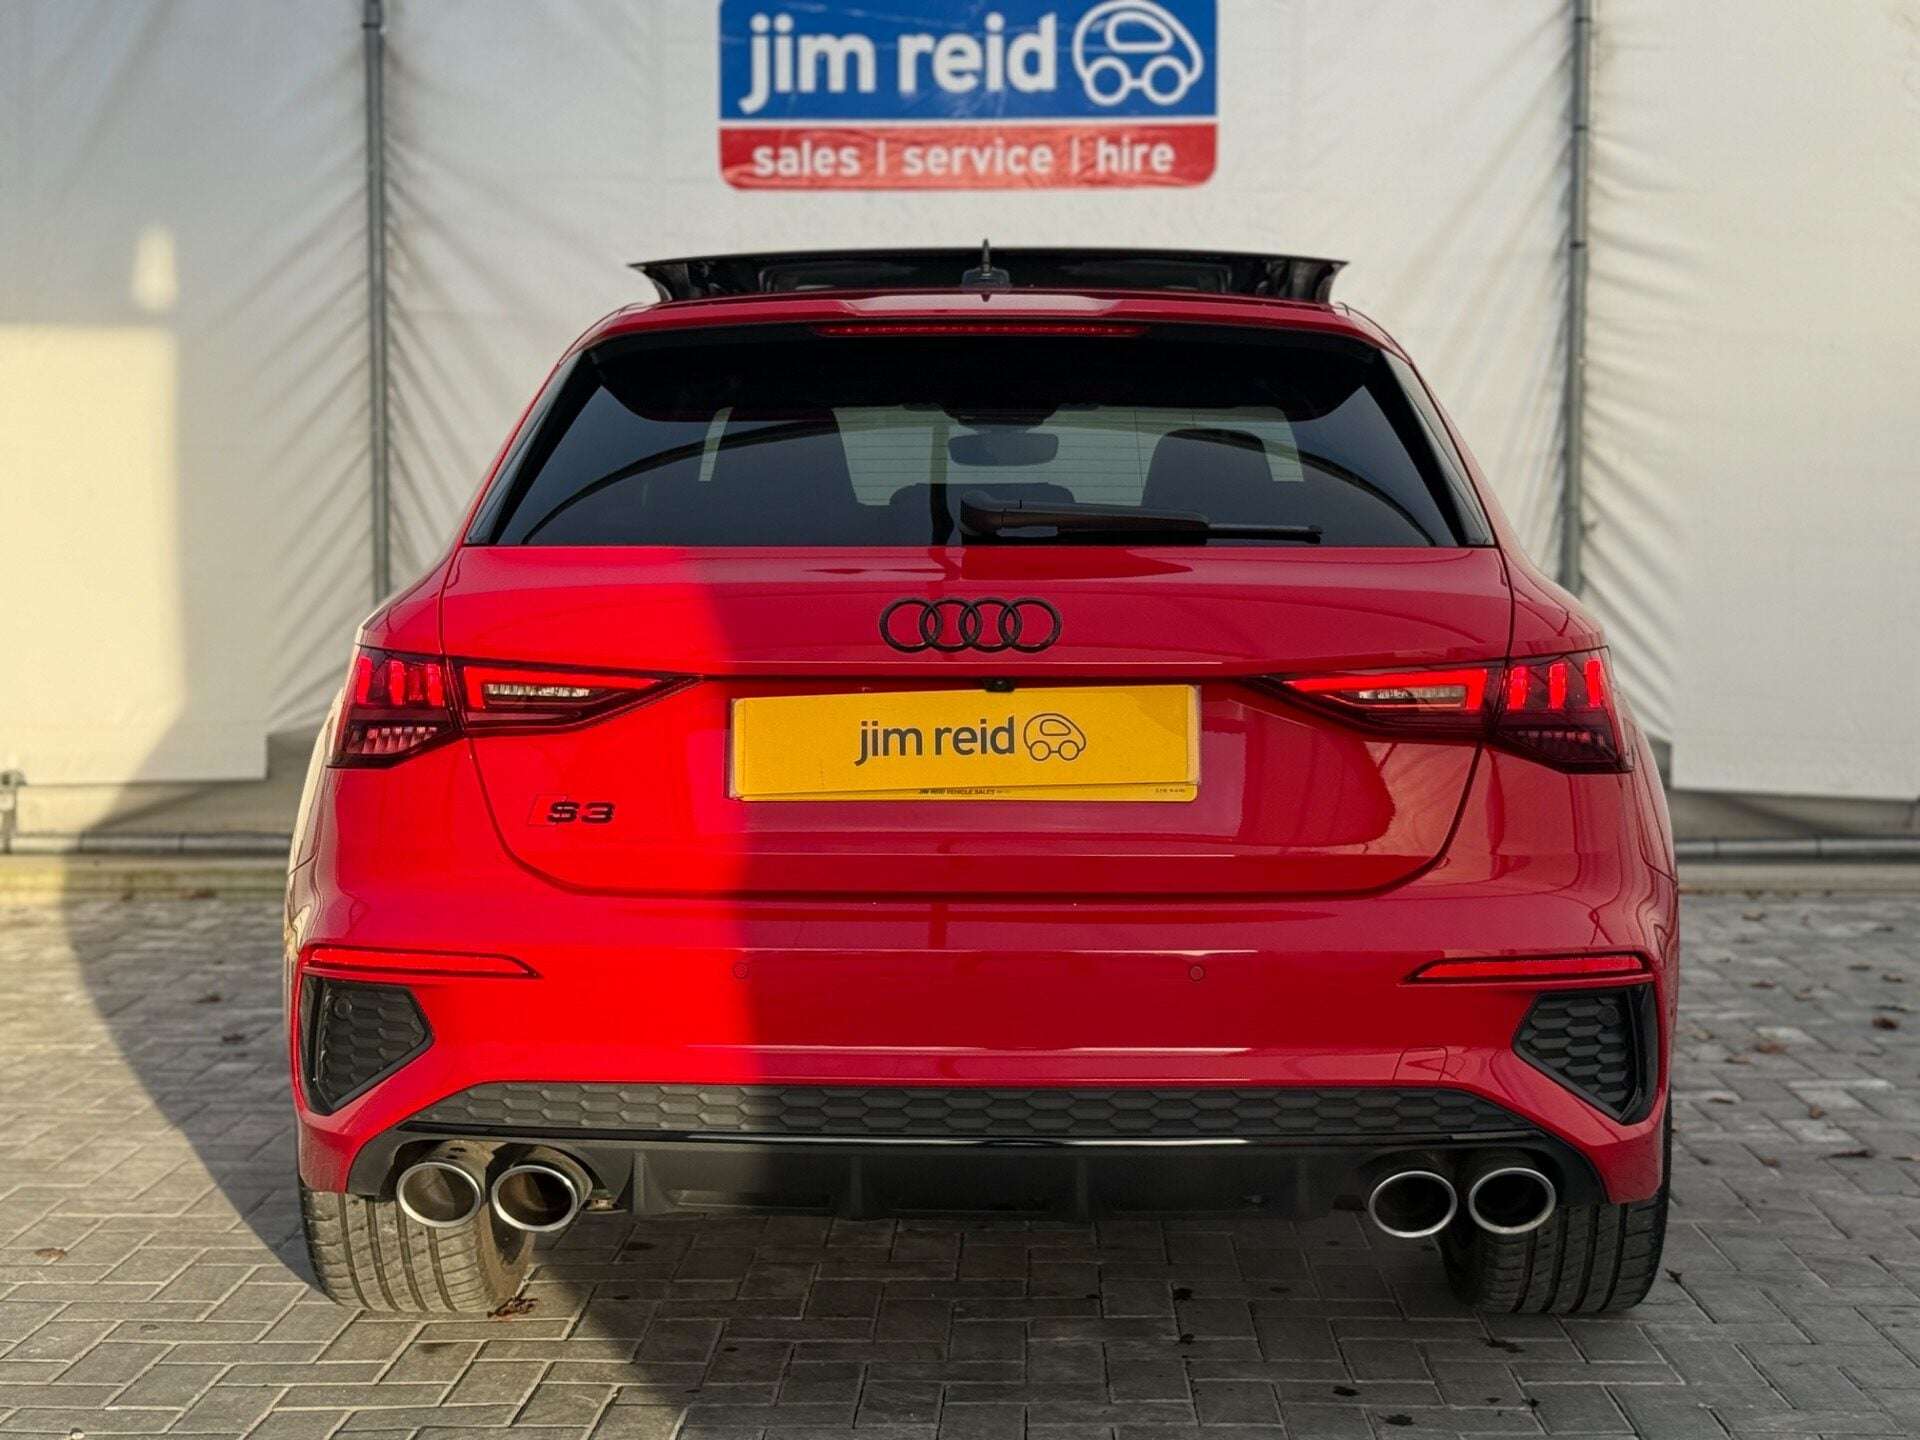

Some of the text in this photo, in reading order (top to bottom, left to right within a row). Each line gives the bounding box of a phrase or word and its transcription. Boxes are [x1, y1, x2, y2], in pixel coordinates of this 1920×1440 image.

[738, 12, 1058, 115] jim reid
[752, 136, 1175, 177] sales service hire
[854, 714, 1015, 766] jim reid
[547, 801, 615, 824] S3
